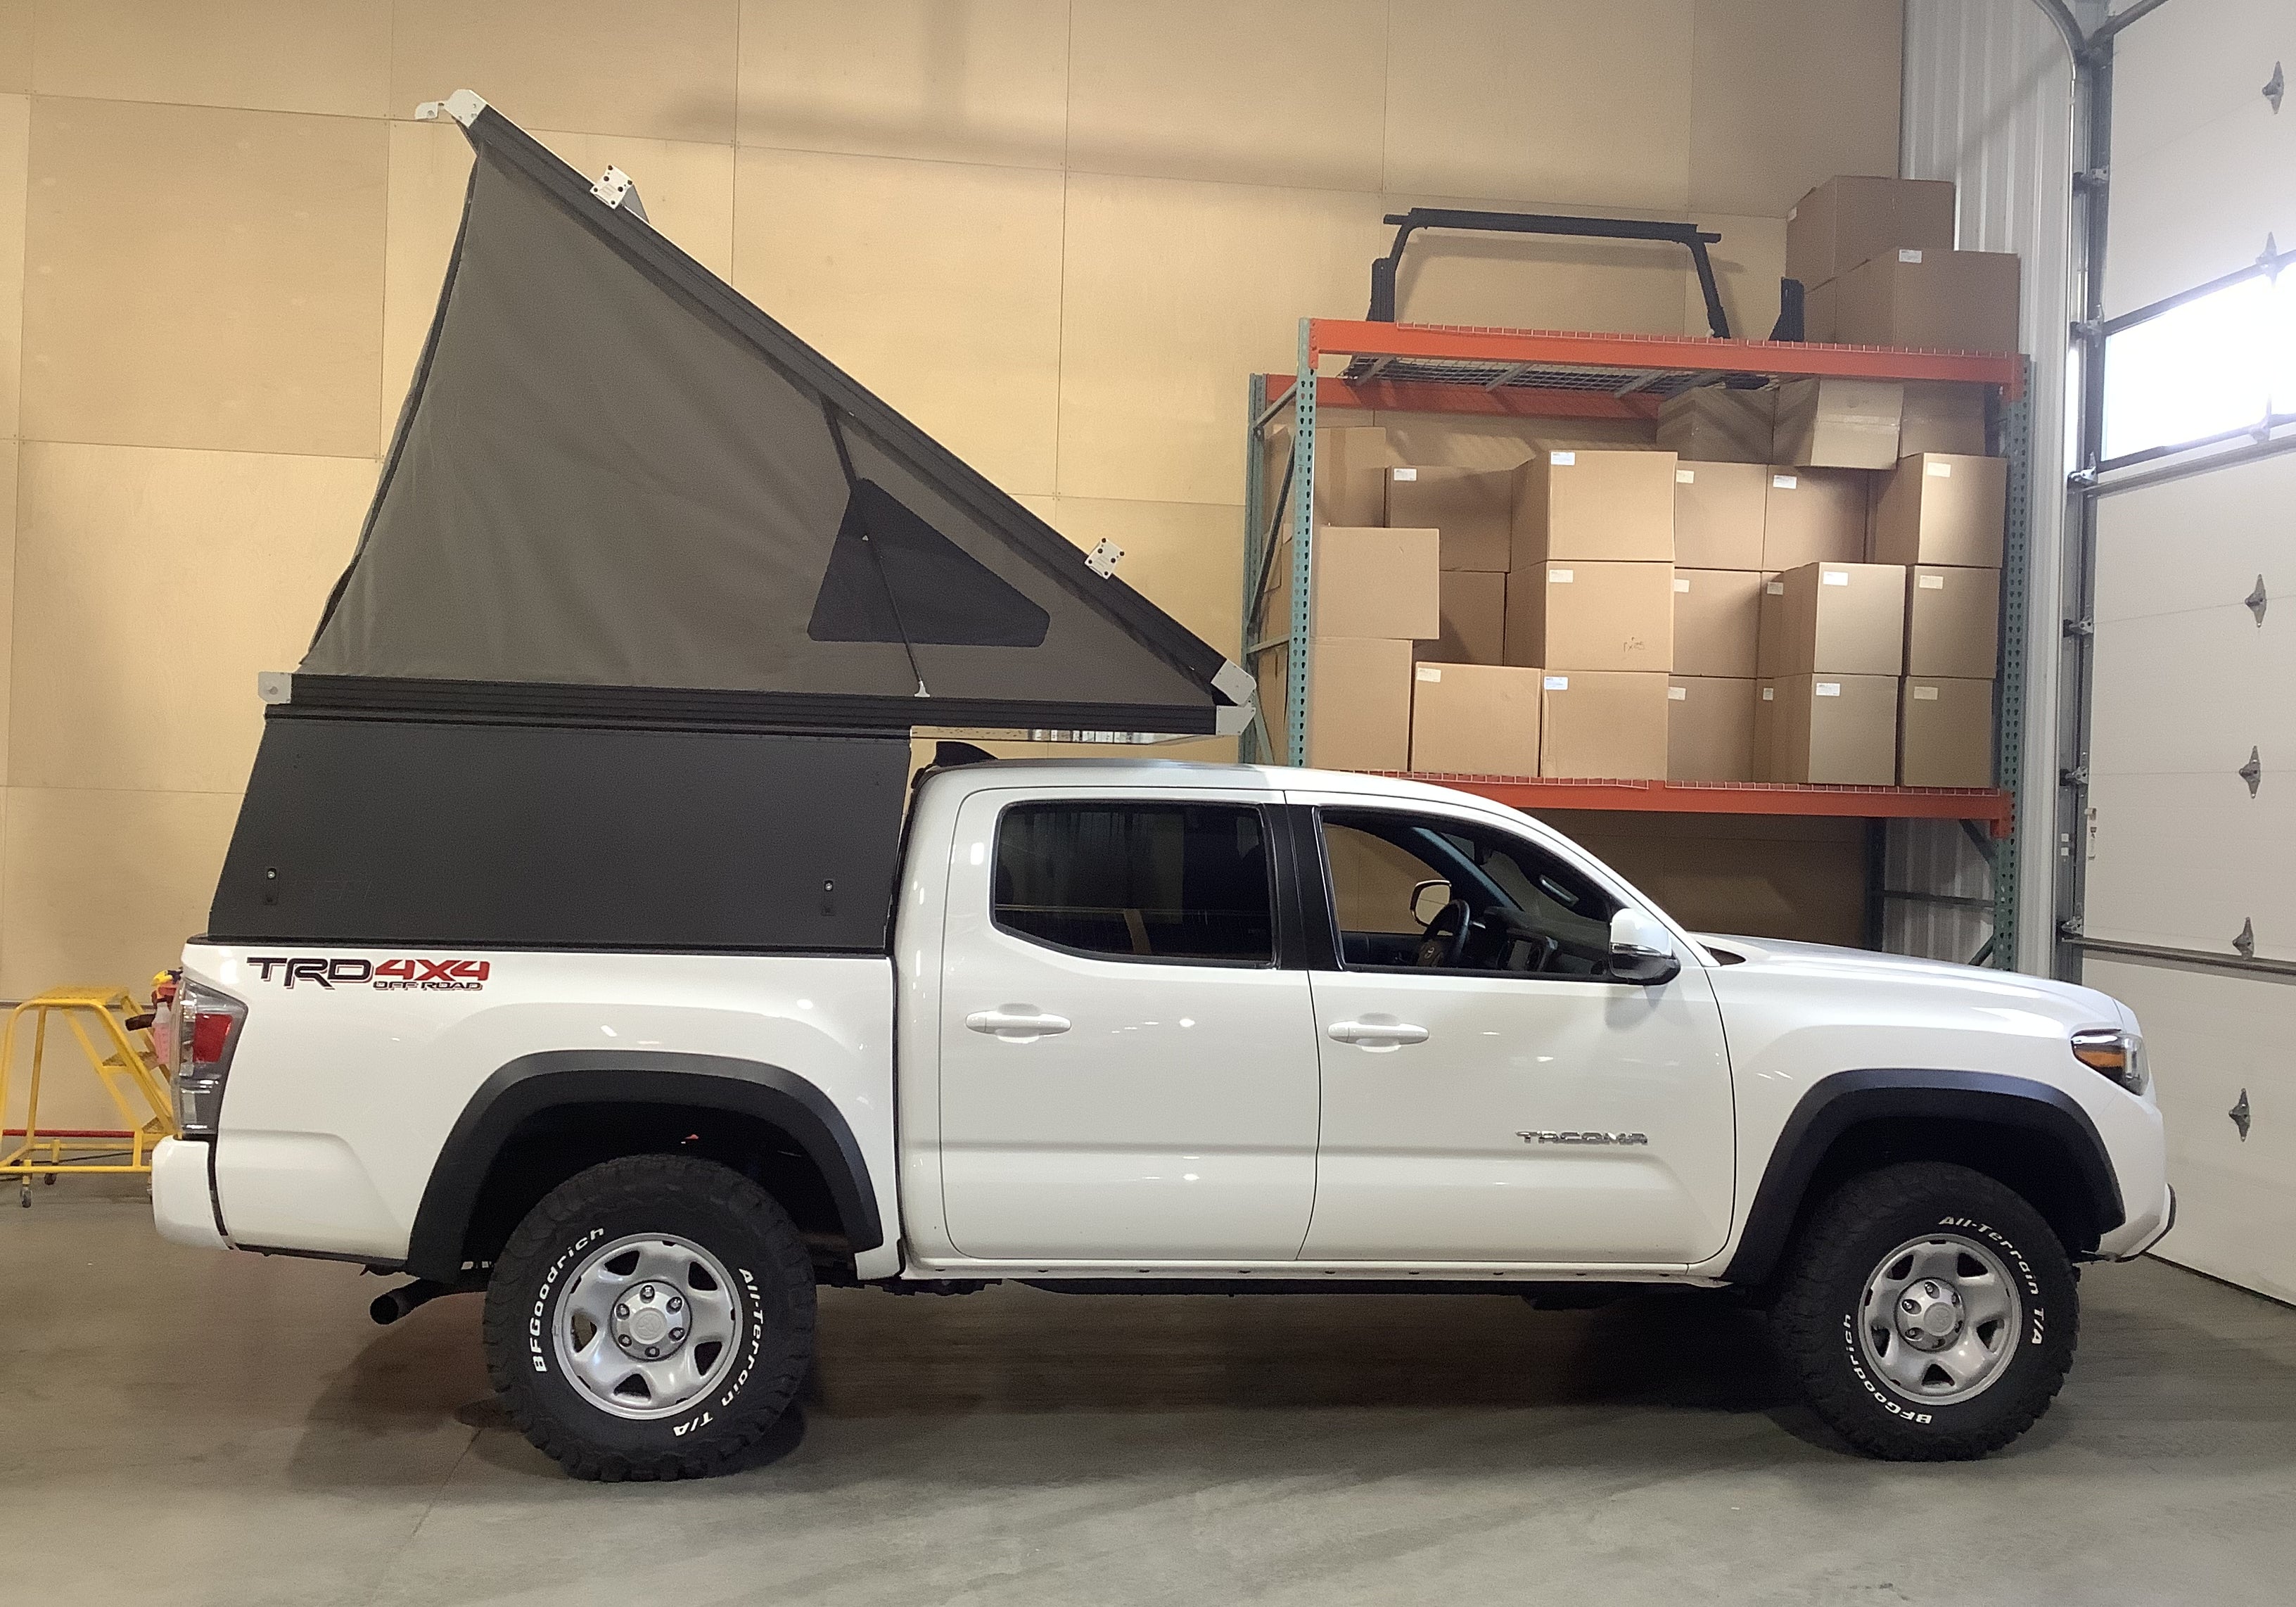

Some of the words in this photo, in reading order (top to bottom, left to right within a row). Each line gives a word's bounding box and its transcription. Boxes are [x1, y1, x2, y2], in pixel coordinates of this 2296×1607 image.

[246, 957, 372, 989] TRD
[374, 959, 490, 982] 4X4
[372, 981, 417, 991] OFF
[420, 982, 483, 991] ROAD
[528, 1227, 604, 1372] BFGoodrich
[721, 1267, 764, 1406] All-Terrain
[1938, 1216, 2039, 1295] All-Terrain
[2031, 1307, 2045, 1345] T/A
[672, 1410, 713, 1437] T/A
[1842, 1313, 1933, 1425] BFGoodrich
